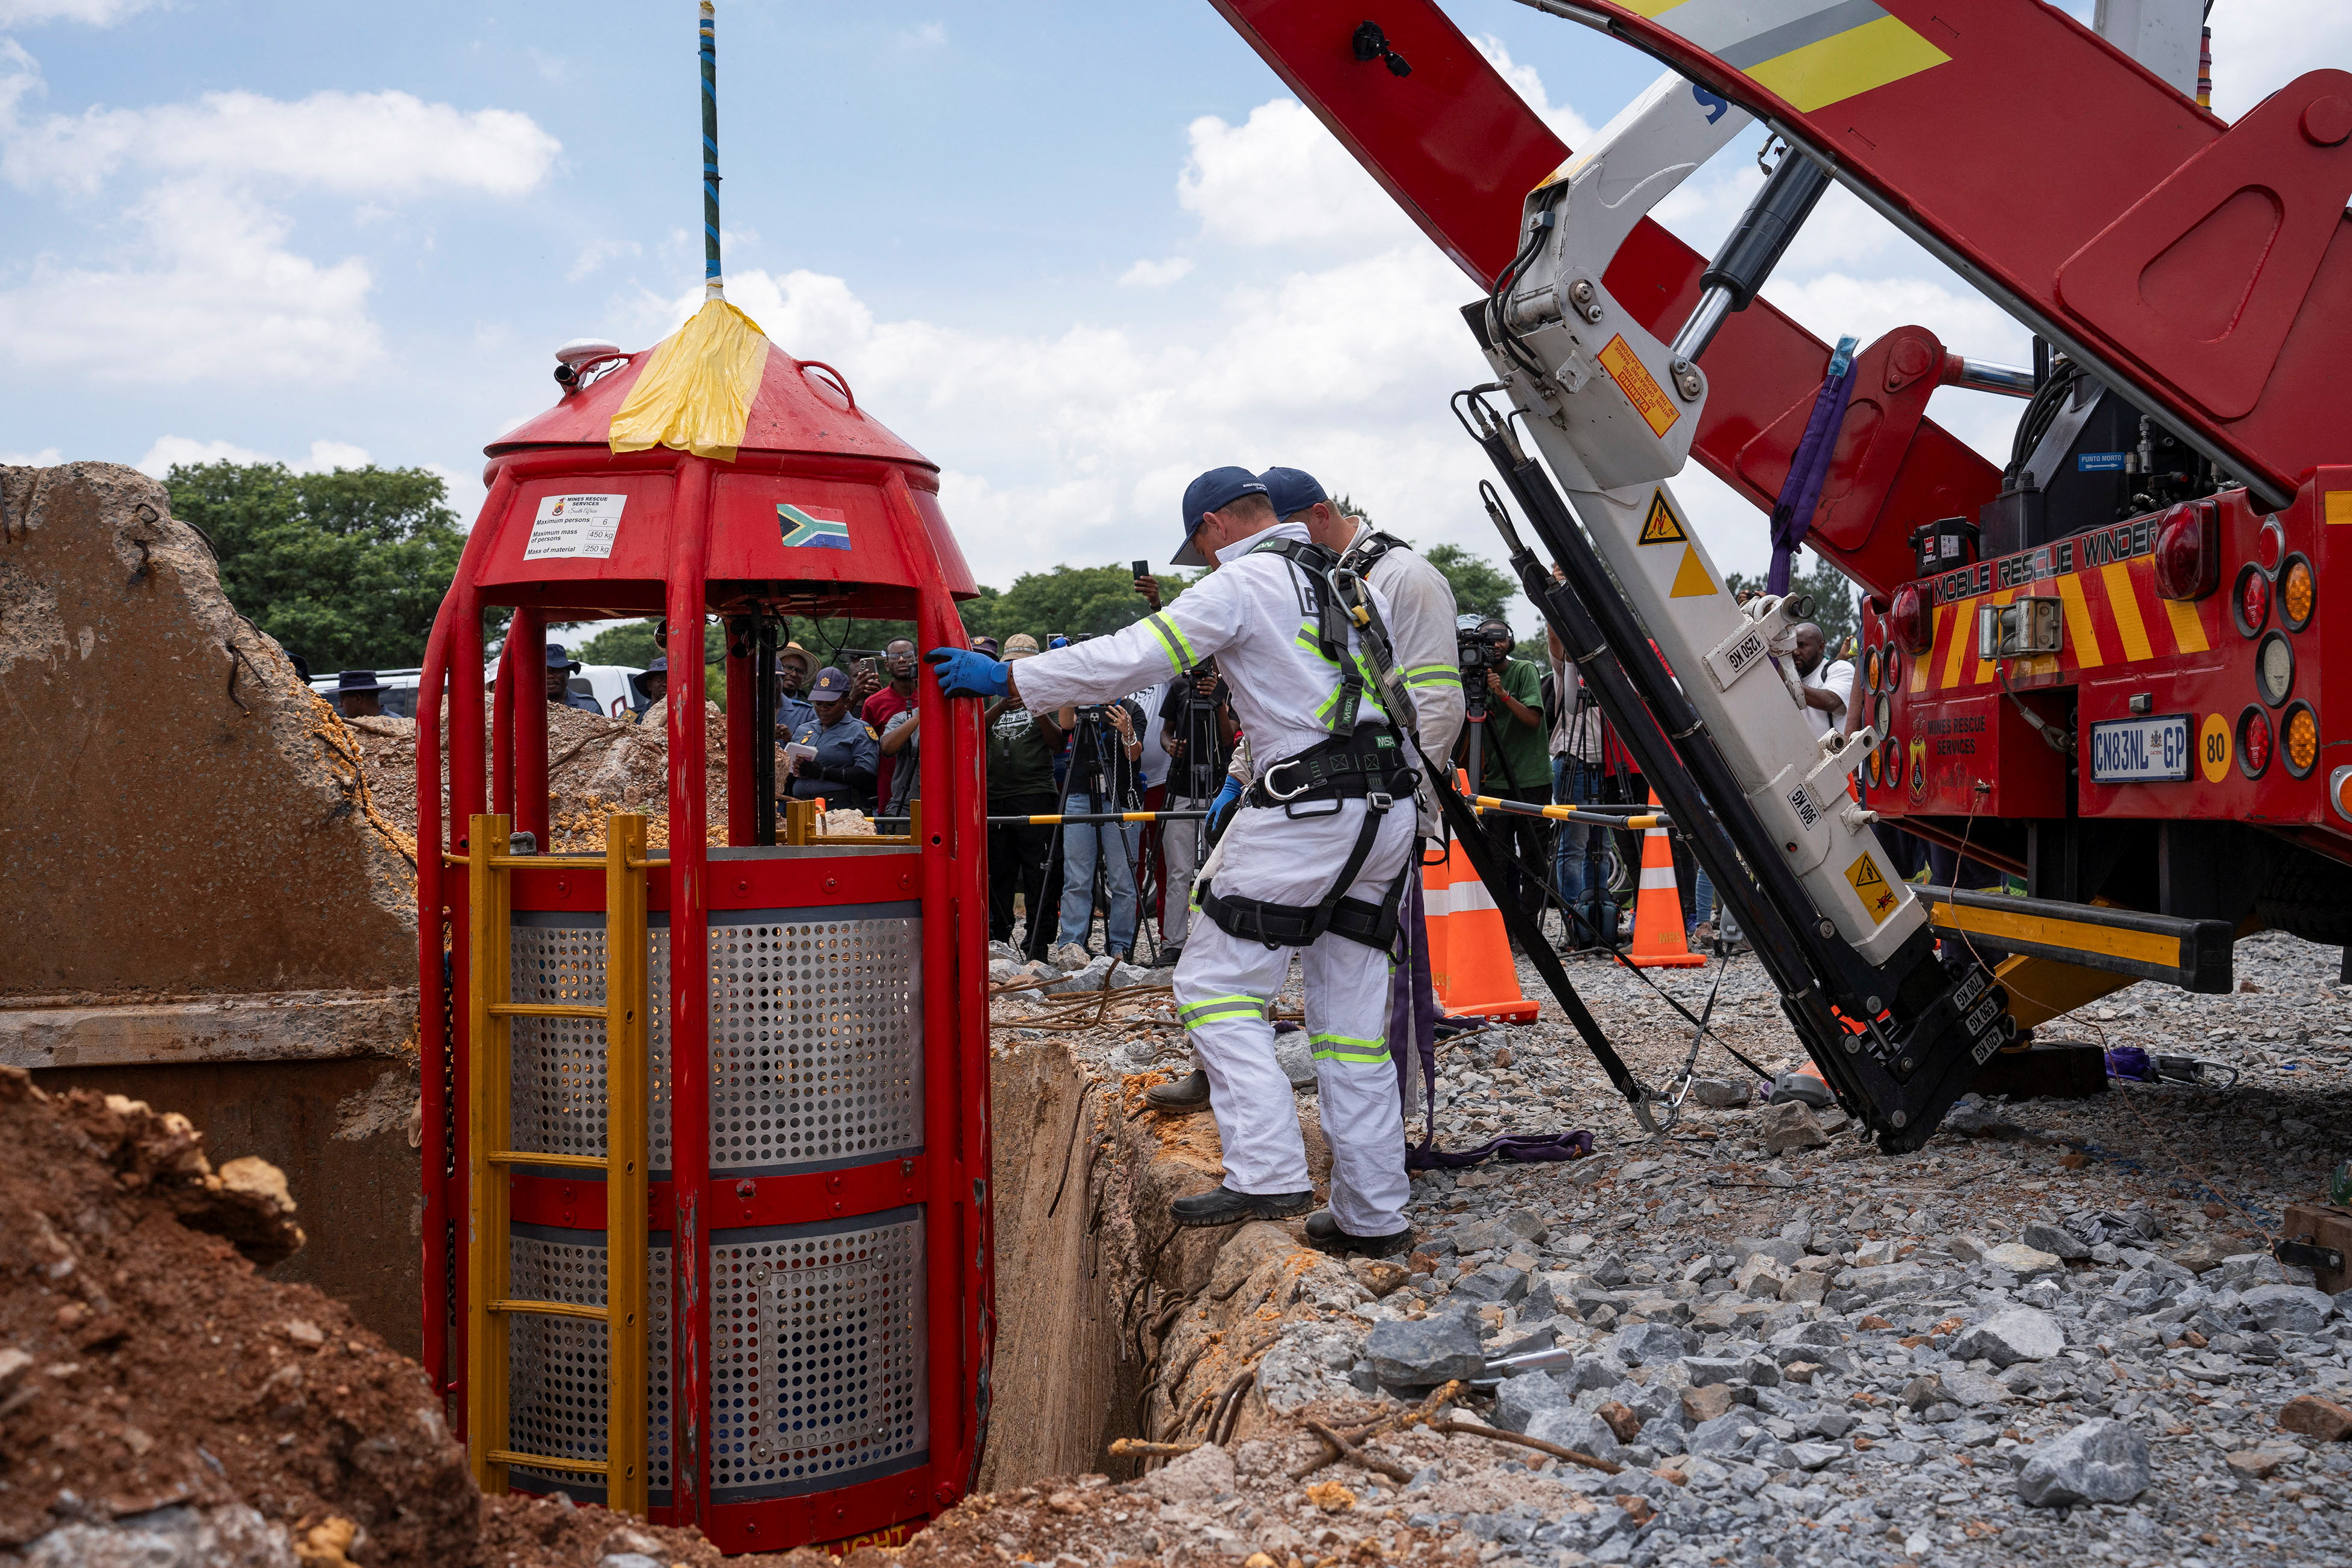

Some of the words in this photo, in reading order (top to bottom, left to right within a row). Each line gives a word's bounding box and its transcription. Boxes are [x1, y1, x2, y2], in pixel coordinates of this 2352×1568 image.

[1614, 346, 1630, 365] RANGE
[1617, 340, 1640, 370] PLATFORM
[1622, 365, 1637, 384] STAND
[1630, 367, 1655, 397] OPERATING
[1644, 375, 1658, 393] BOOM
[1619, 373, 1649, 411] WARNING
[1637, 385, 1648, 398] NOT
[1659, 394, 1668, 406] THE
[1648, 399, 1656, 408] DO
[1655, 399, 1671, 419] WITHIN
[1668, 407, 1675, 416] OF
[1933, 563, 1990, 605] MOBILE
[1997, 541, 2073, 590] RESCUE
[1740, 634, 1762, 659] 1250
[1729, 648, 1745, 669] KG
[1015, 712, 1028, 721] Buk
[1343, 698, 1355, 721] MSA
[1927, 718, 1951, 735] MINES
[1953, 715, 1986, 734] RESCUE
[1377, 736, 1396, 747] MSA
[1937, 738, 1975, 755] SERVICES
[2096, 729, 2149, 771] CN83NL
[2164, 726, 2184, 768] GP
[2207, 733, 2225, 763] 80
[1792, 789, 1806, 809] KG
[1801, 806, 1816, 825] 900
[1659, 932, 1681, 944] MRS
[1967, 976, 1982, 996] 700
[1956, 988, 1970, 1007] KG
[1969, 1013, 1984, 1031] KG
[1985, 1030, 2000, 1050] 420
[1975, 1042, 1990, 1061] KG
